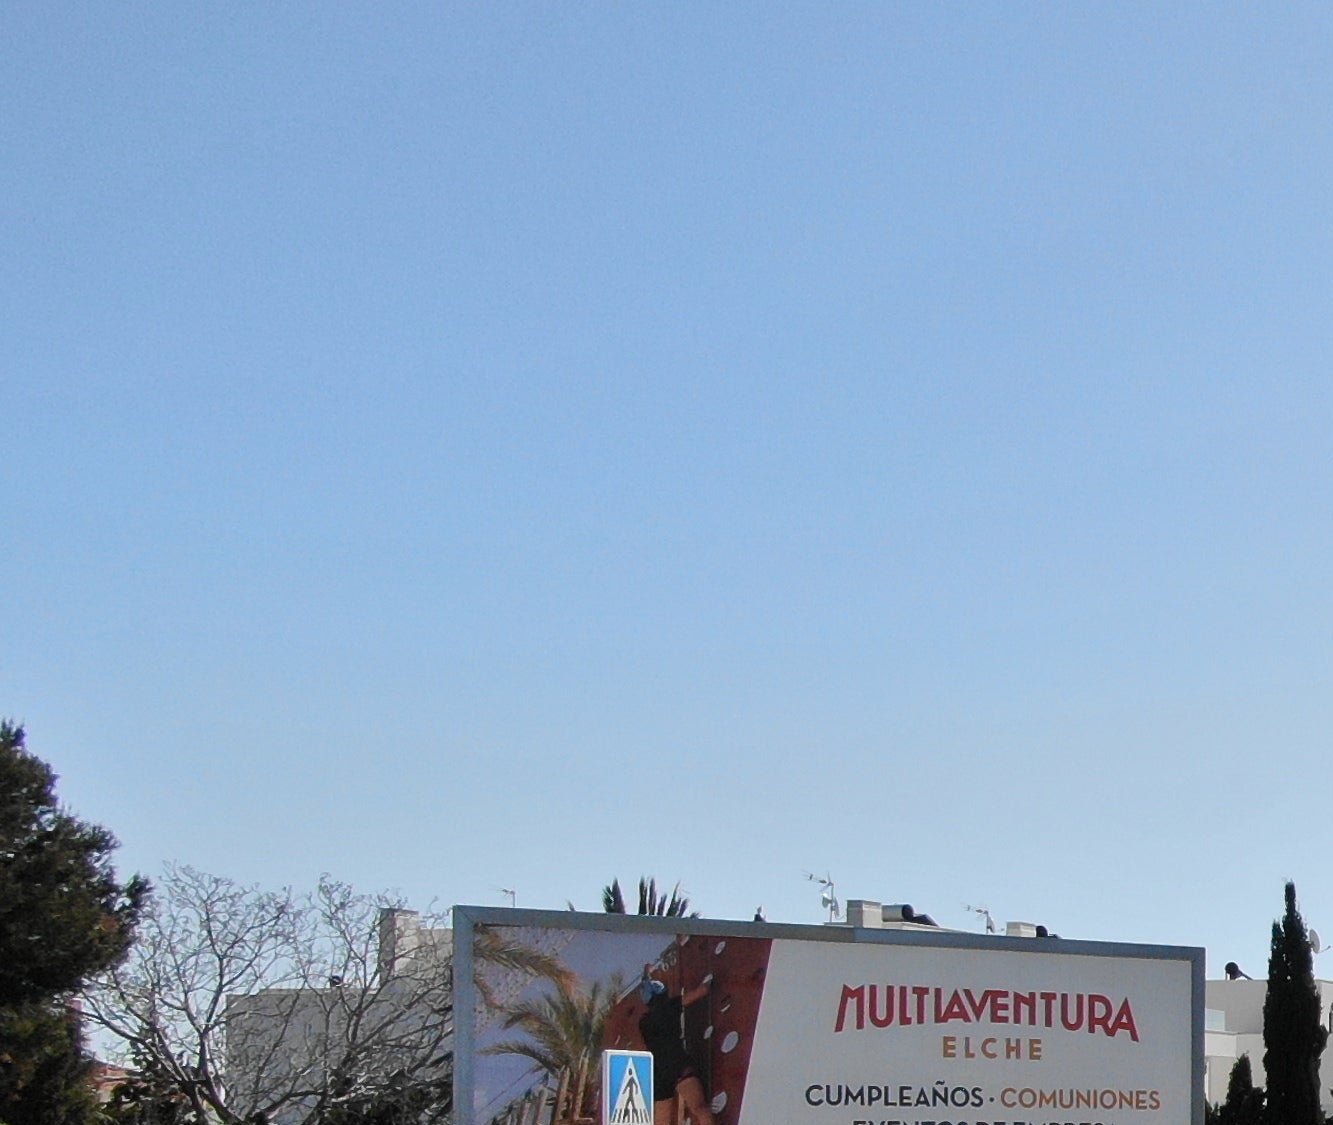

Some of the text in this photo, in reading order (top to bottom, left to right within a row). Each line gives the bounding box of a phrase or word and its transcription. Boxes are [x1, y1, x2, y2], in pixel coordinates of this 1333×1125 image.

[834, 983, 1140, 1042] MULTIAVENTURA
[942, 1036, 1042, 1060] ELCHE
[805, 1080, 1161, 1110] CUMPLEAÑOS COMUNIONES
